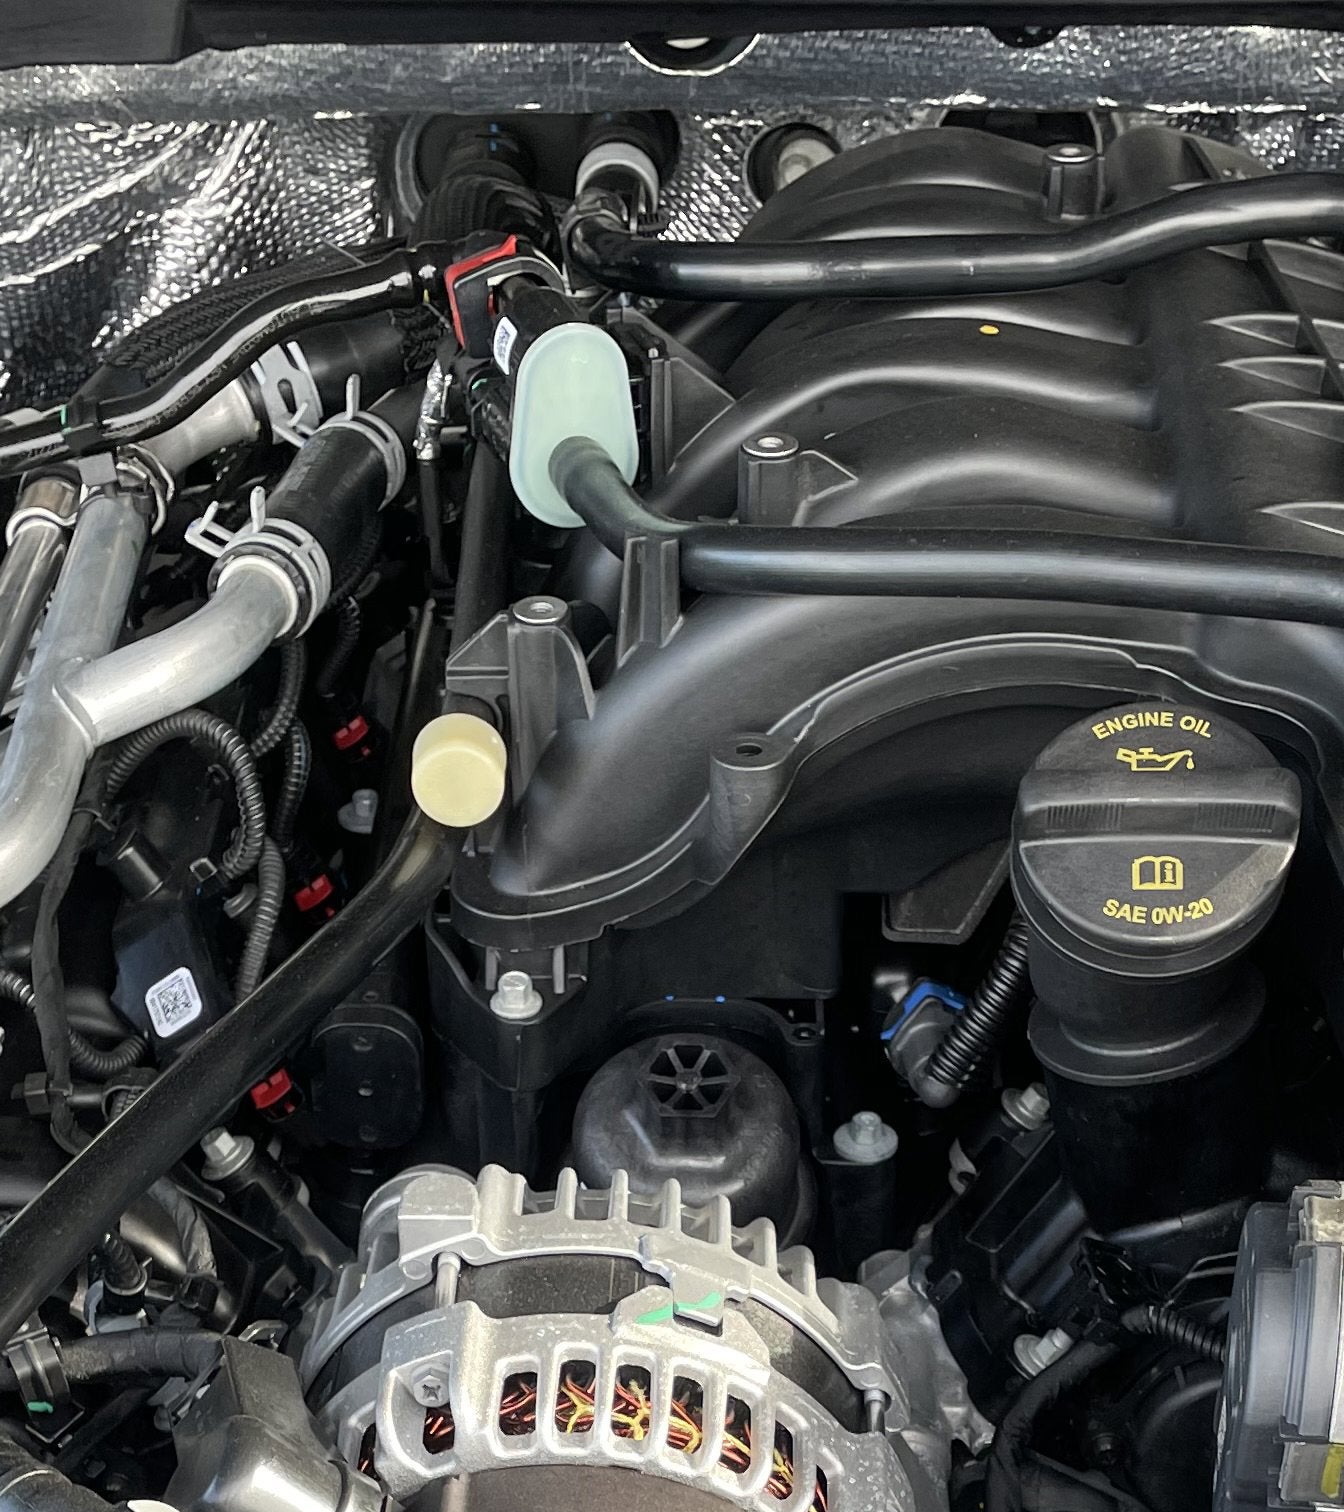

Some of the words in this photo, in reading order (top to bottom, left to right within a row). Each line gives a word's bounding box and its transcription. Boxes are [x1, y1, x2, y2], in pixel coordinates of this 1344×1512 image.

[1092, 711, 1174, 740] ENGINE
[1179, 715, 1212, 738] OIL
[1102, 899, 1147, 924] SAE
[1152, 898, 1214, 924] 0W-20
